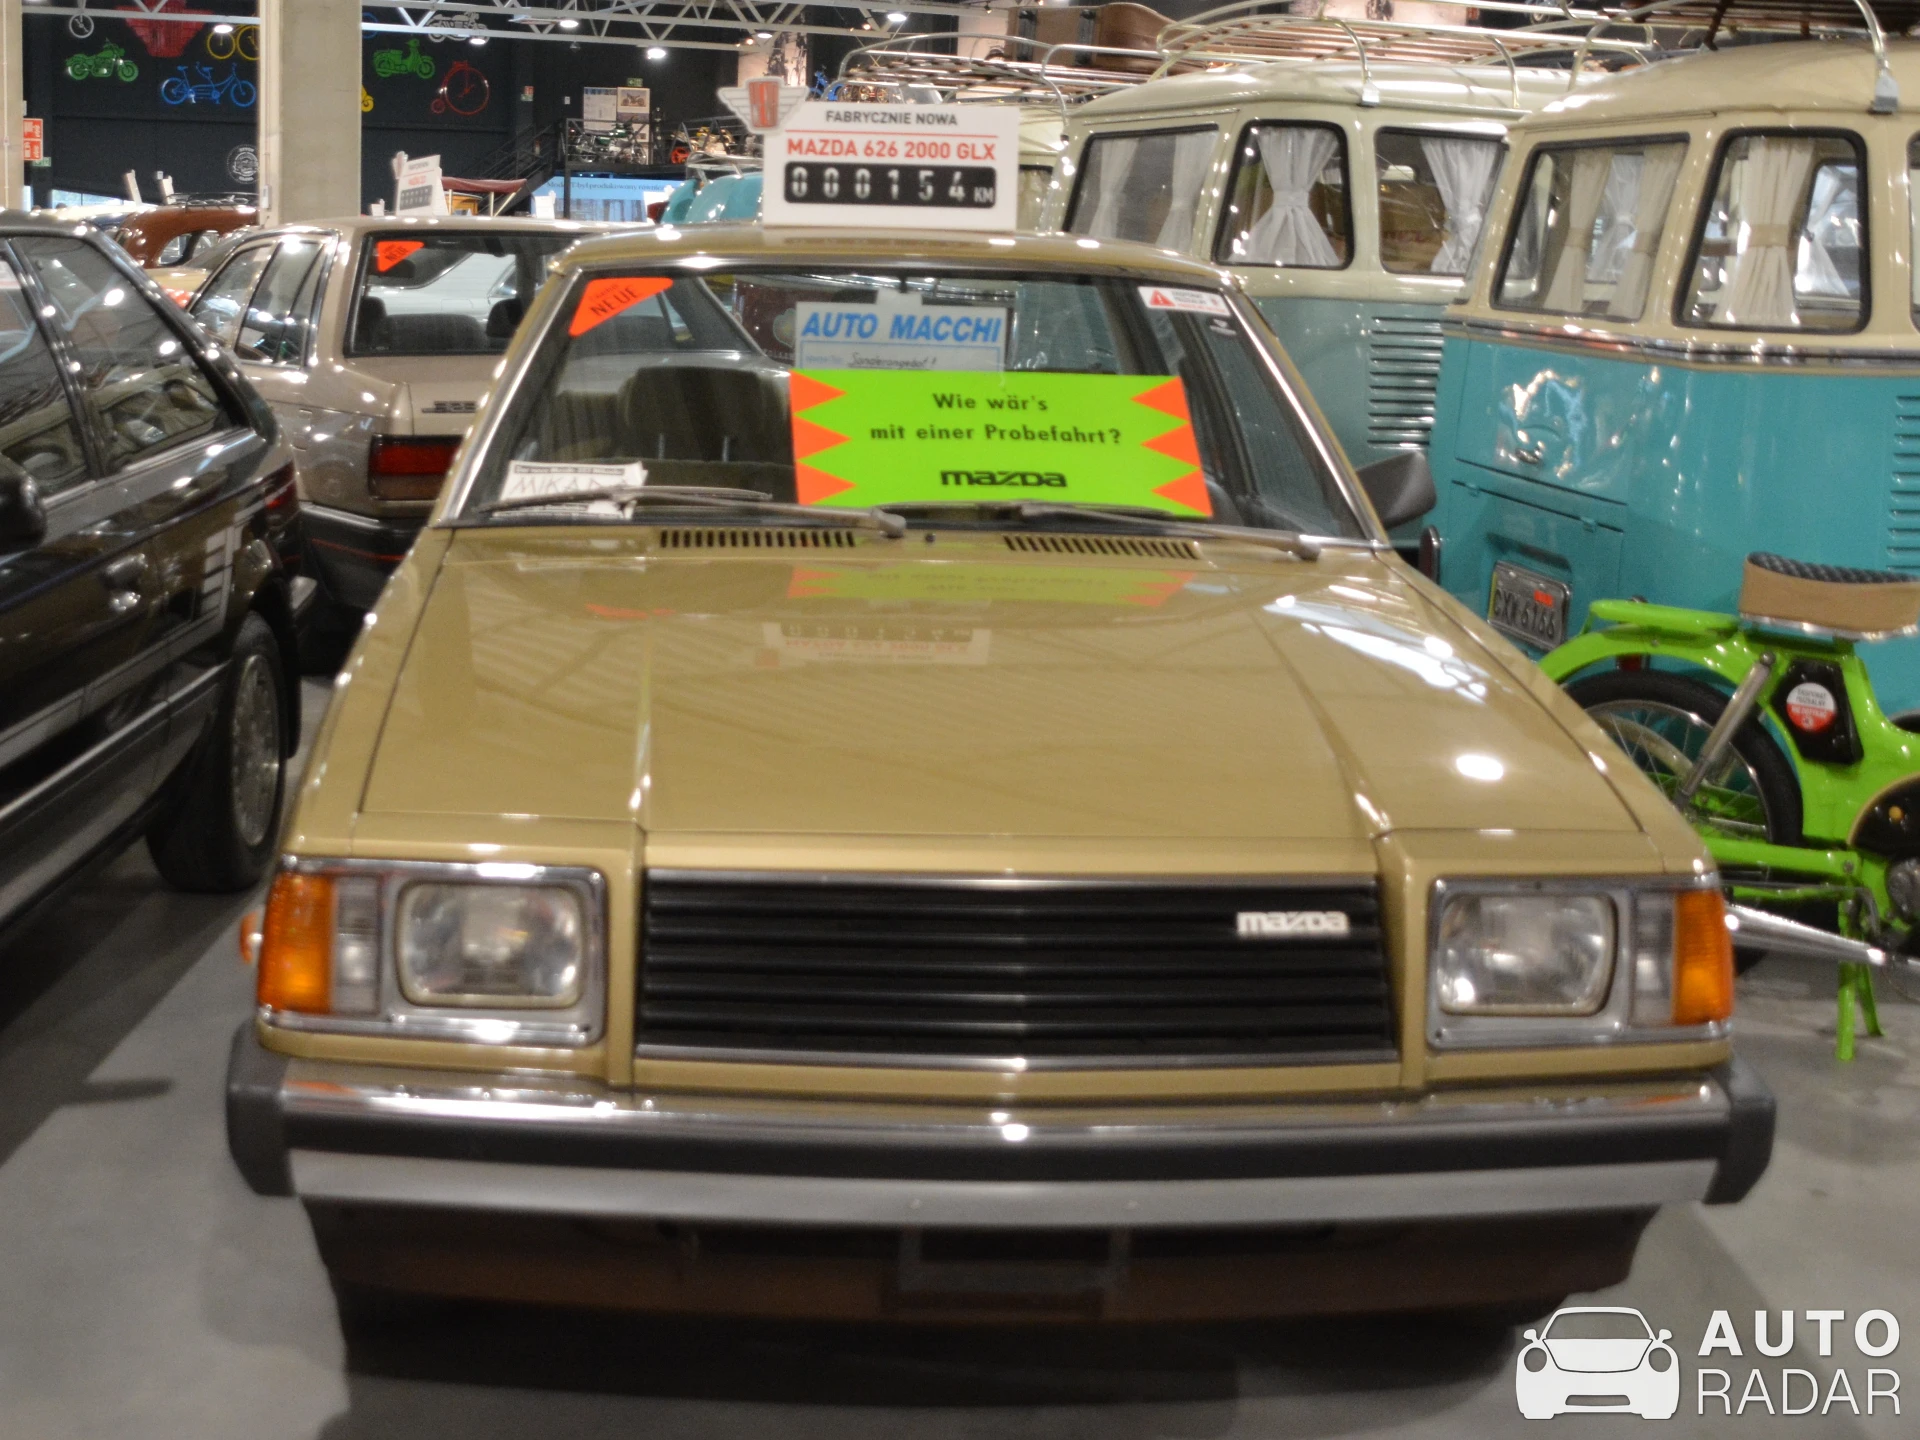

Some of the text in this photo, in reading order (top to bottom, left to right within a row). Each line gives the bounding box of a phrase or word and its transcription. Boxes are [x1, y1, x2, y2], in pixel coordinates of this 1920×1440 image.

[826, 110, 957, 126] FABRYCZNIE NOWA
[787, 138, 996, 161] MAZDA 626 2000 GLX
[974, 186, 994, 202] KM
[802, 312, 1003, 343] AUTO MACCHI
[932, 392, 1048, 411] Wie wär's
[870, 424, 1121, 444] mit einer Probefahrt?
[940, 470, 1068, 487] mazda
[1237, 911, 1349, 936] mazda
